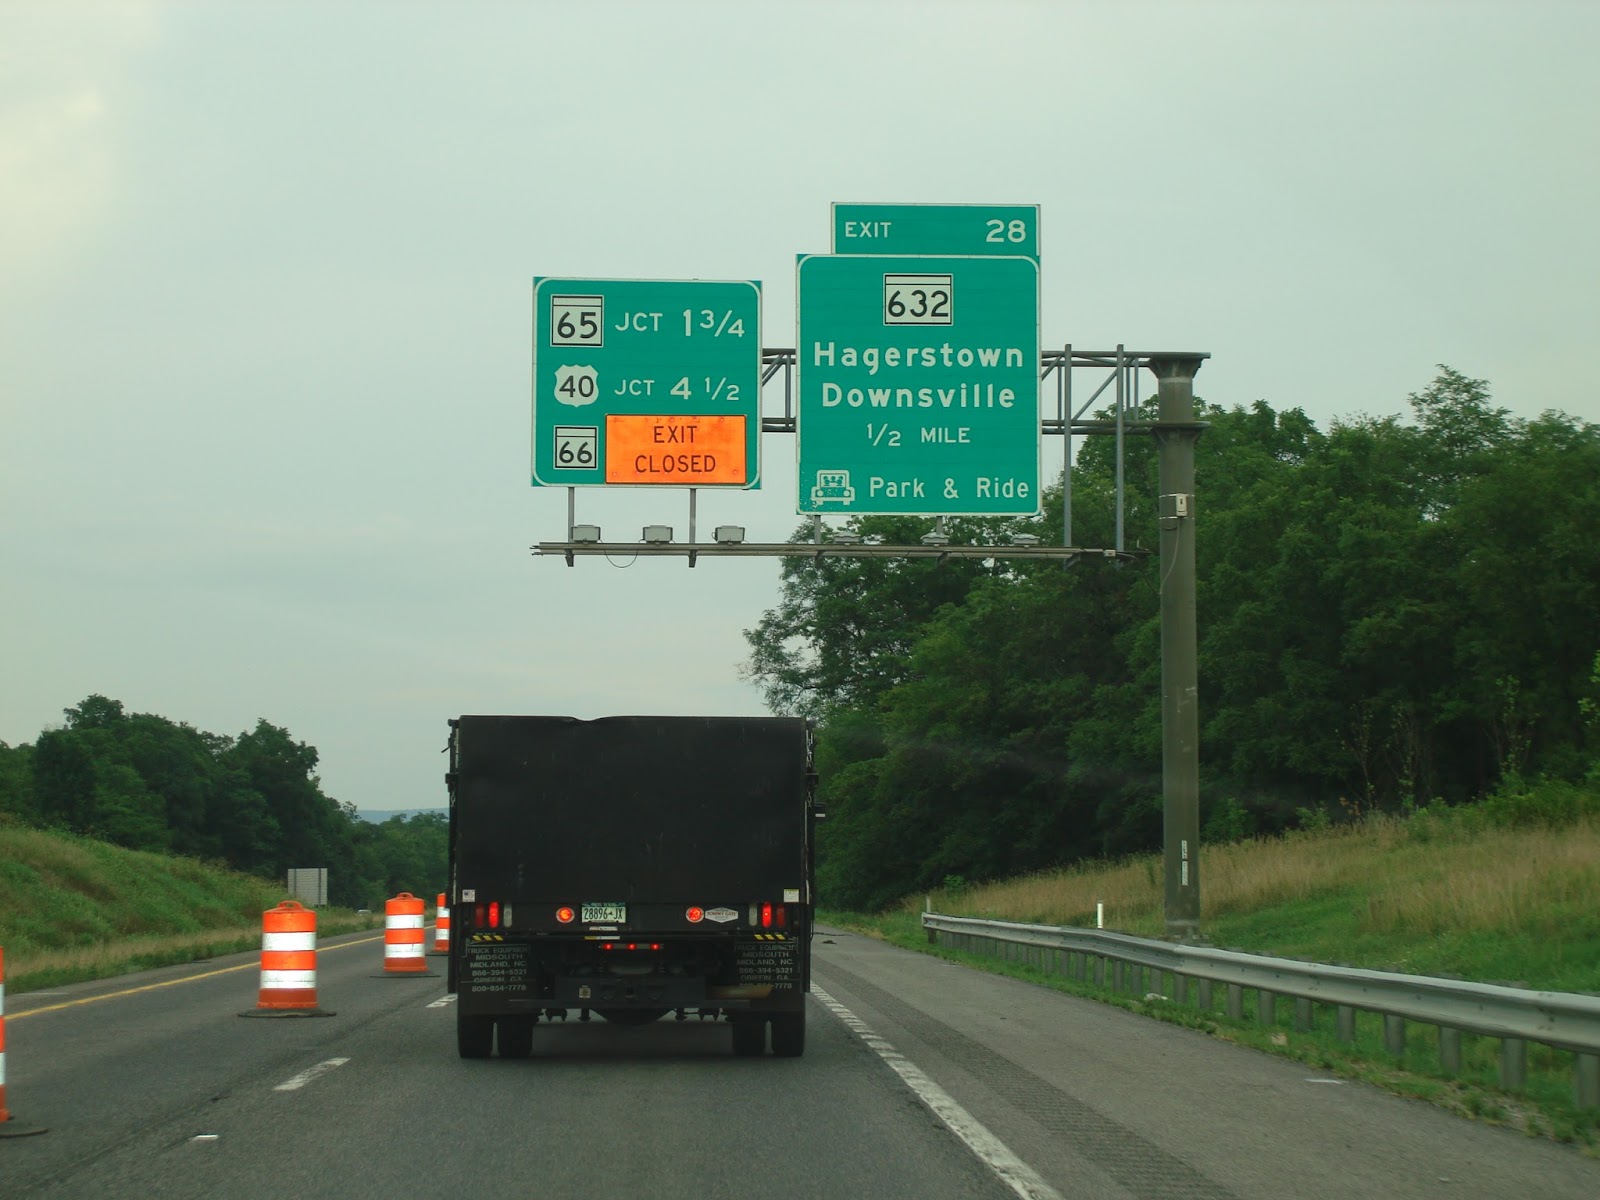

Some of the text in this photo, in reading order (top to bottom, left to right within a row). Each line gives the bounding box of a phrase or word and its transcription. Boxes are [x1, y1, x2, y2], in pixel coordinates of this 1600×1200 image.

[844, 219, 1027, 243] EXIT 28
[887, 289, 949, 318] 632
[556, 311, 598, 339] 65
[614, 309, 745, 338] JCT 1 3/4
[814, 341, 1024, 376] Hagerstown
[558, 375, 594, 398] 40
[614, 376, 740, 401] JCT 4 1/2
[822, 382, 1016, 408] Downsville
[653, 425, 698, 444] EXIT
[866, 423, 971, 447] 1/2 MILE
[558, 440, 593, 464] 66
[634, 454, 716, 473] CLOSED
[869, 476, 1030, 499] Park & Ride
[475, 953, 523, 961] MIDSOUTH
[471, 968, 527, 977] 866-394-5321
[471, 984, 527, 993] 800-854-7778
